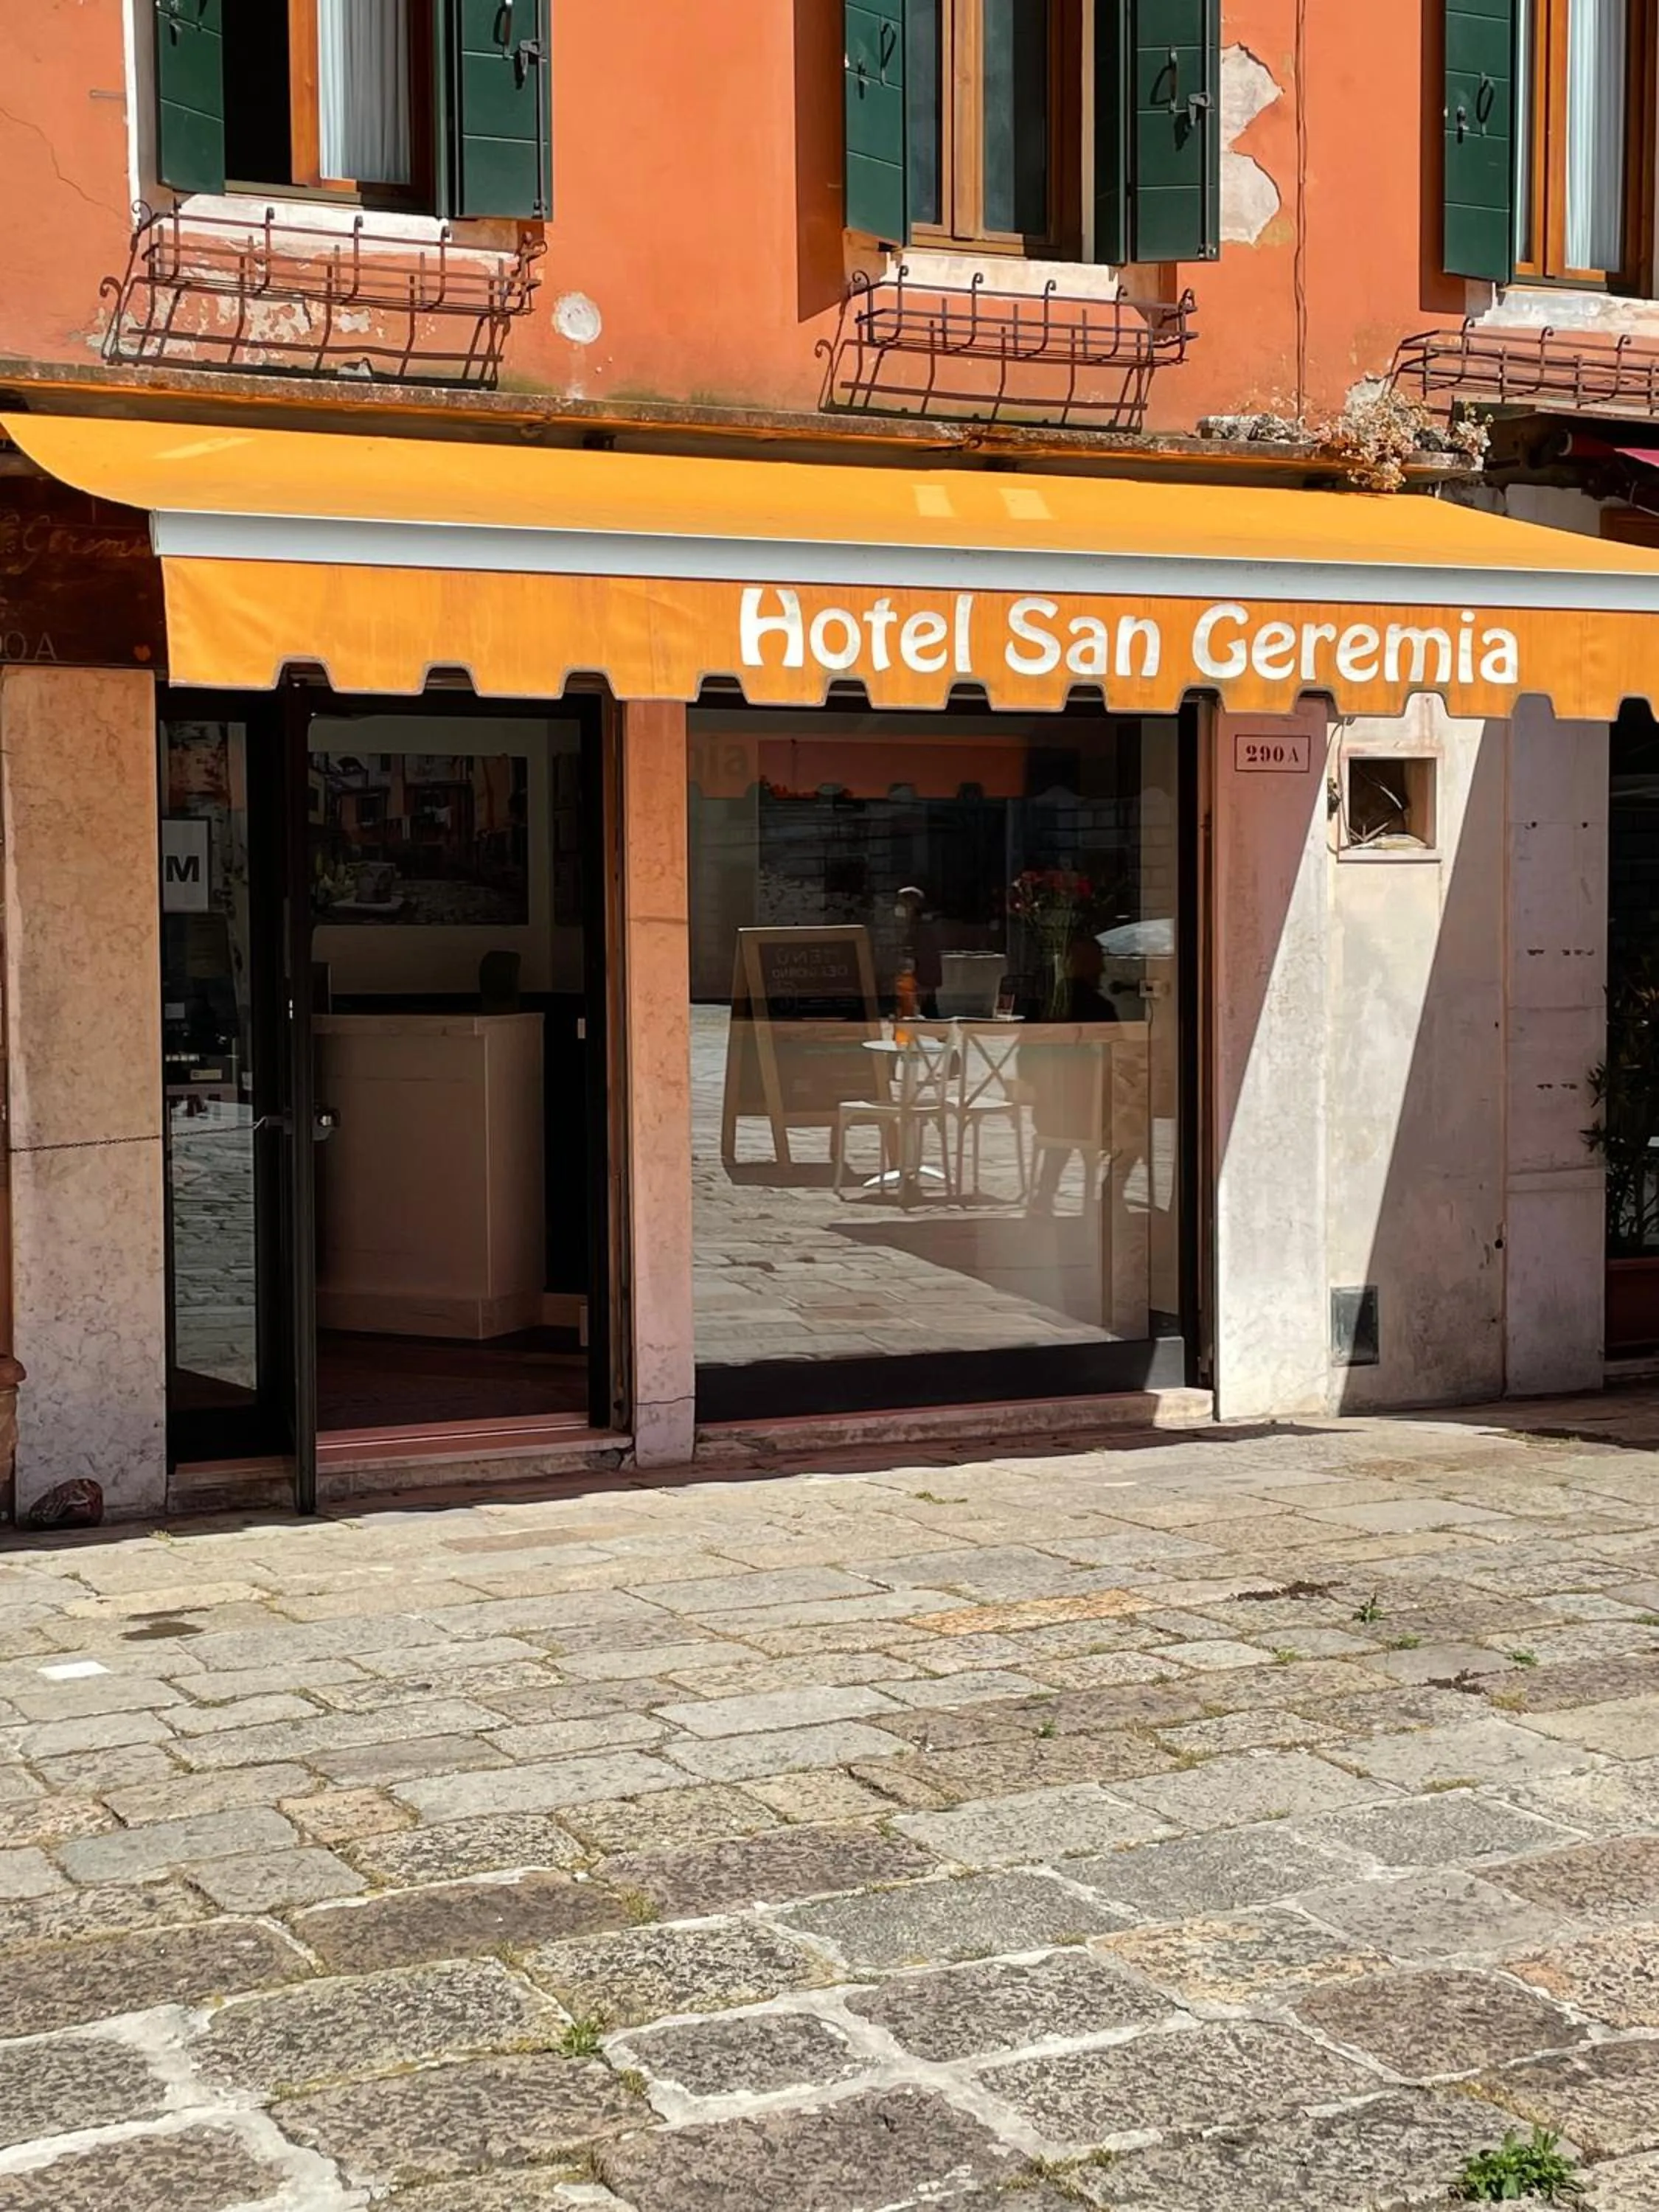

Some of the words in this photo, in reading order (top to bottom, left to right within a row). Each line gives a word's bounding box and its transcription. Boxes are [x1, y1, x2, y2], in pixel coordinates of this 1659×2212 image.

[740, 588, 973, 673] Hotel
[1005, 597, 1161, 677] San
[1192, 603, 1518, 684] Geremia
[1246, 745, 1298, 762] 290A
